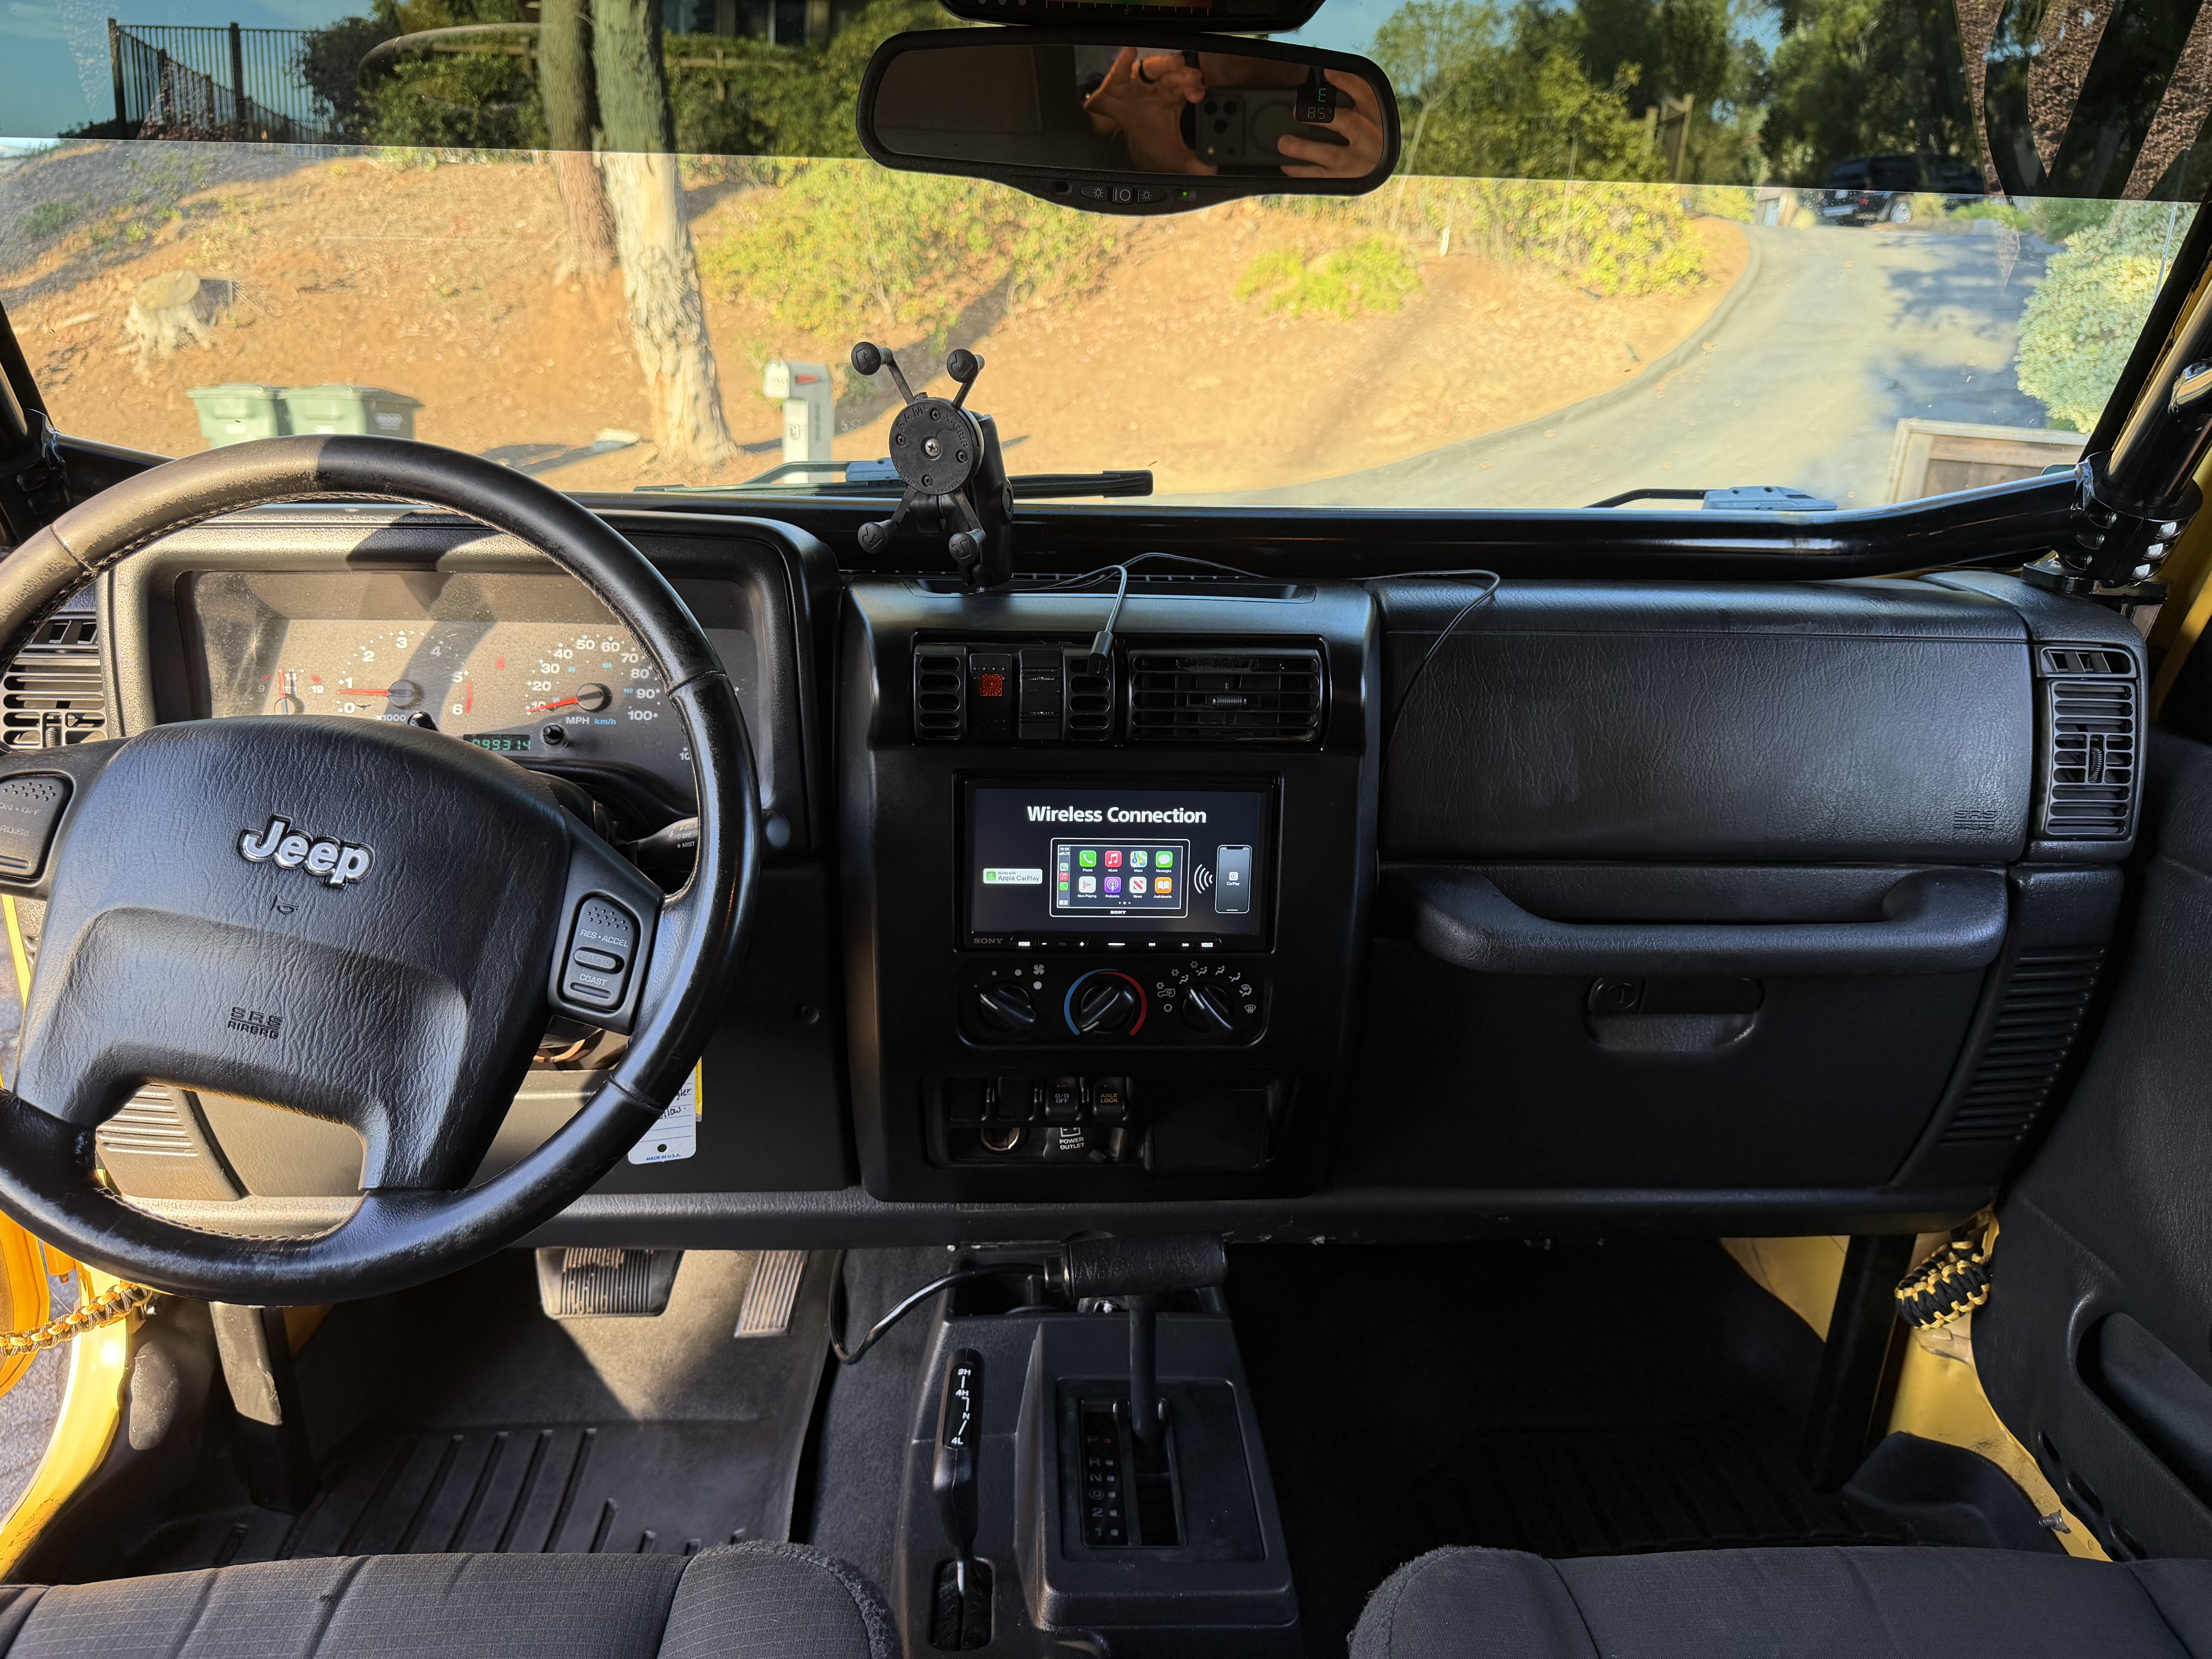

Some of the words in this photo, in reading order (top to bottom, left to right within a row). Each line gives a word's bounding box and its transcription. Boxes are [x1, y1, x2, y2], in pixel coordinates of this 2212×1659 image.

[896, 405, 924, 432] RAM
[396, 637, 408, 649] 3
[576, 640, 595, 650] 50
[601, 641, 620, 652] 60
[362, 650, 374, 662] 2
[431, 646, 441, 656] 4
[554, 649, 573, 659] 40
[621, 653, 639, 663] 70
[541, 663, 560, 674] 30
[630, 668, 649, 679] 80
[345, 677, 353, 688] 1
[452, 671, 464, 683] 5
[311, 685, 324, 694] 19
[532, 681, 551, 691] 20
[636, 689, 655, 699] 90
[344, 702, 356, 713] 0
[452, 703, 464, 715] 6
[566, 716, 590, 725] MPH
[628, 710, 653, 720] 100
[1027, 806, 1103, 822] Wireless
[1107, 807, 1206, 823] Connection
[1954, 809, 1997, 819] SRS
[237, 814, 376, 890] Jeep
[580, 929, 597, 939] RES
[601, 935, 628, 947] ACCEL
[581, 953, 608, 966] CANCEL
[580, 974, 607, 986] COAST
[231, 1007, 283, 1027] SRS
[958, 1368, 971, 1376] 2H
[962, 1412, 970, 1420] N
[1090, 1474, 1102, 1482] N
[1092, 1507, 1103, 1517] 2
[1095, 1528, 1101, 1536] 1
